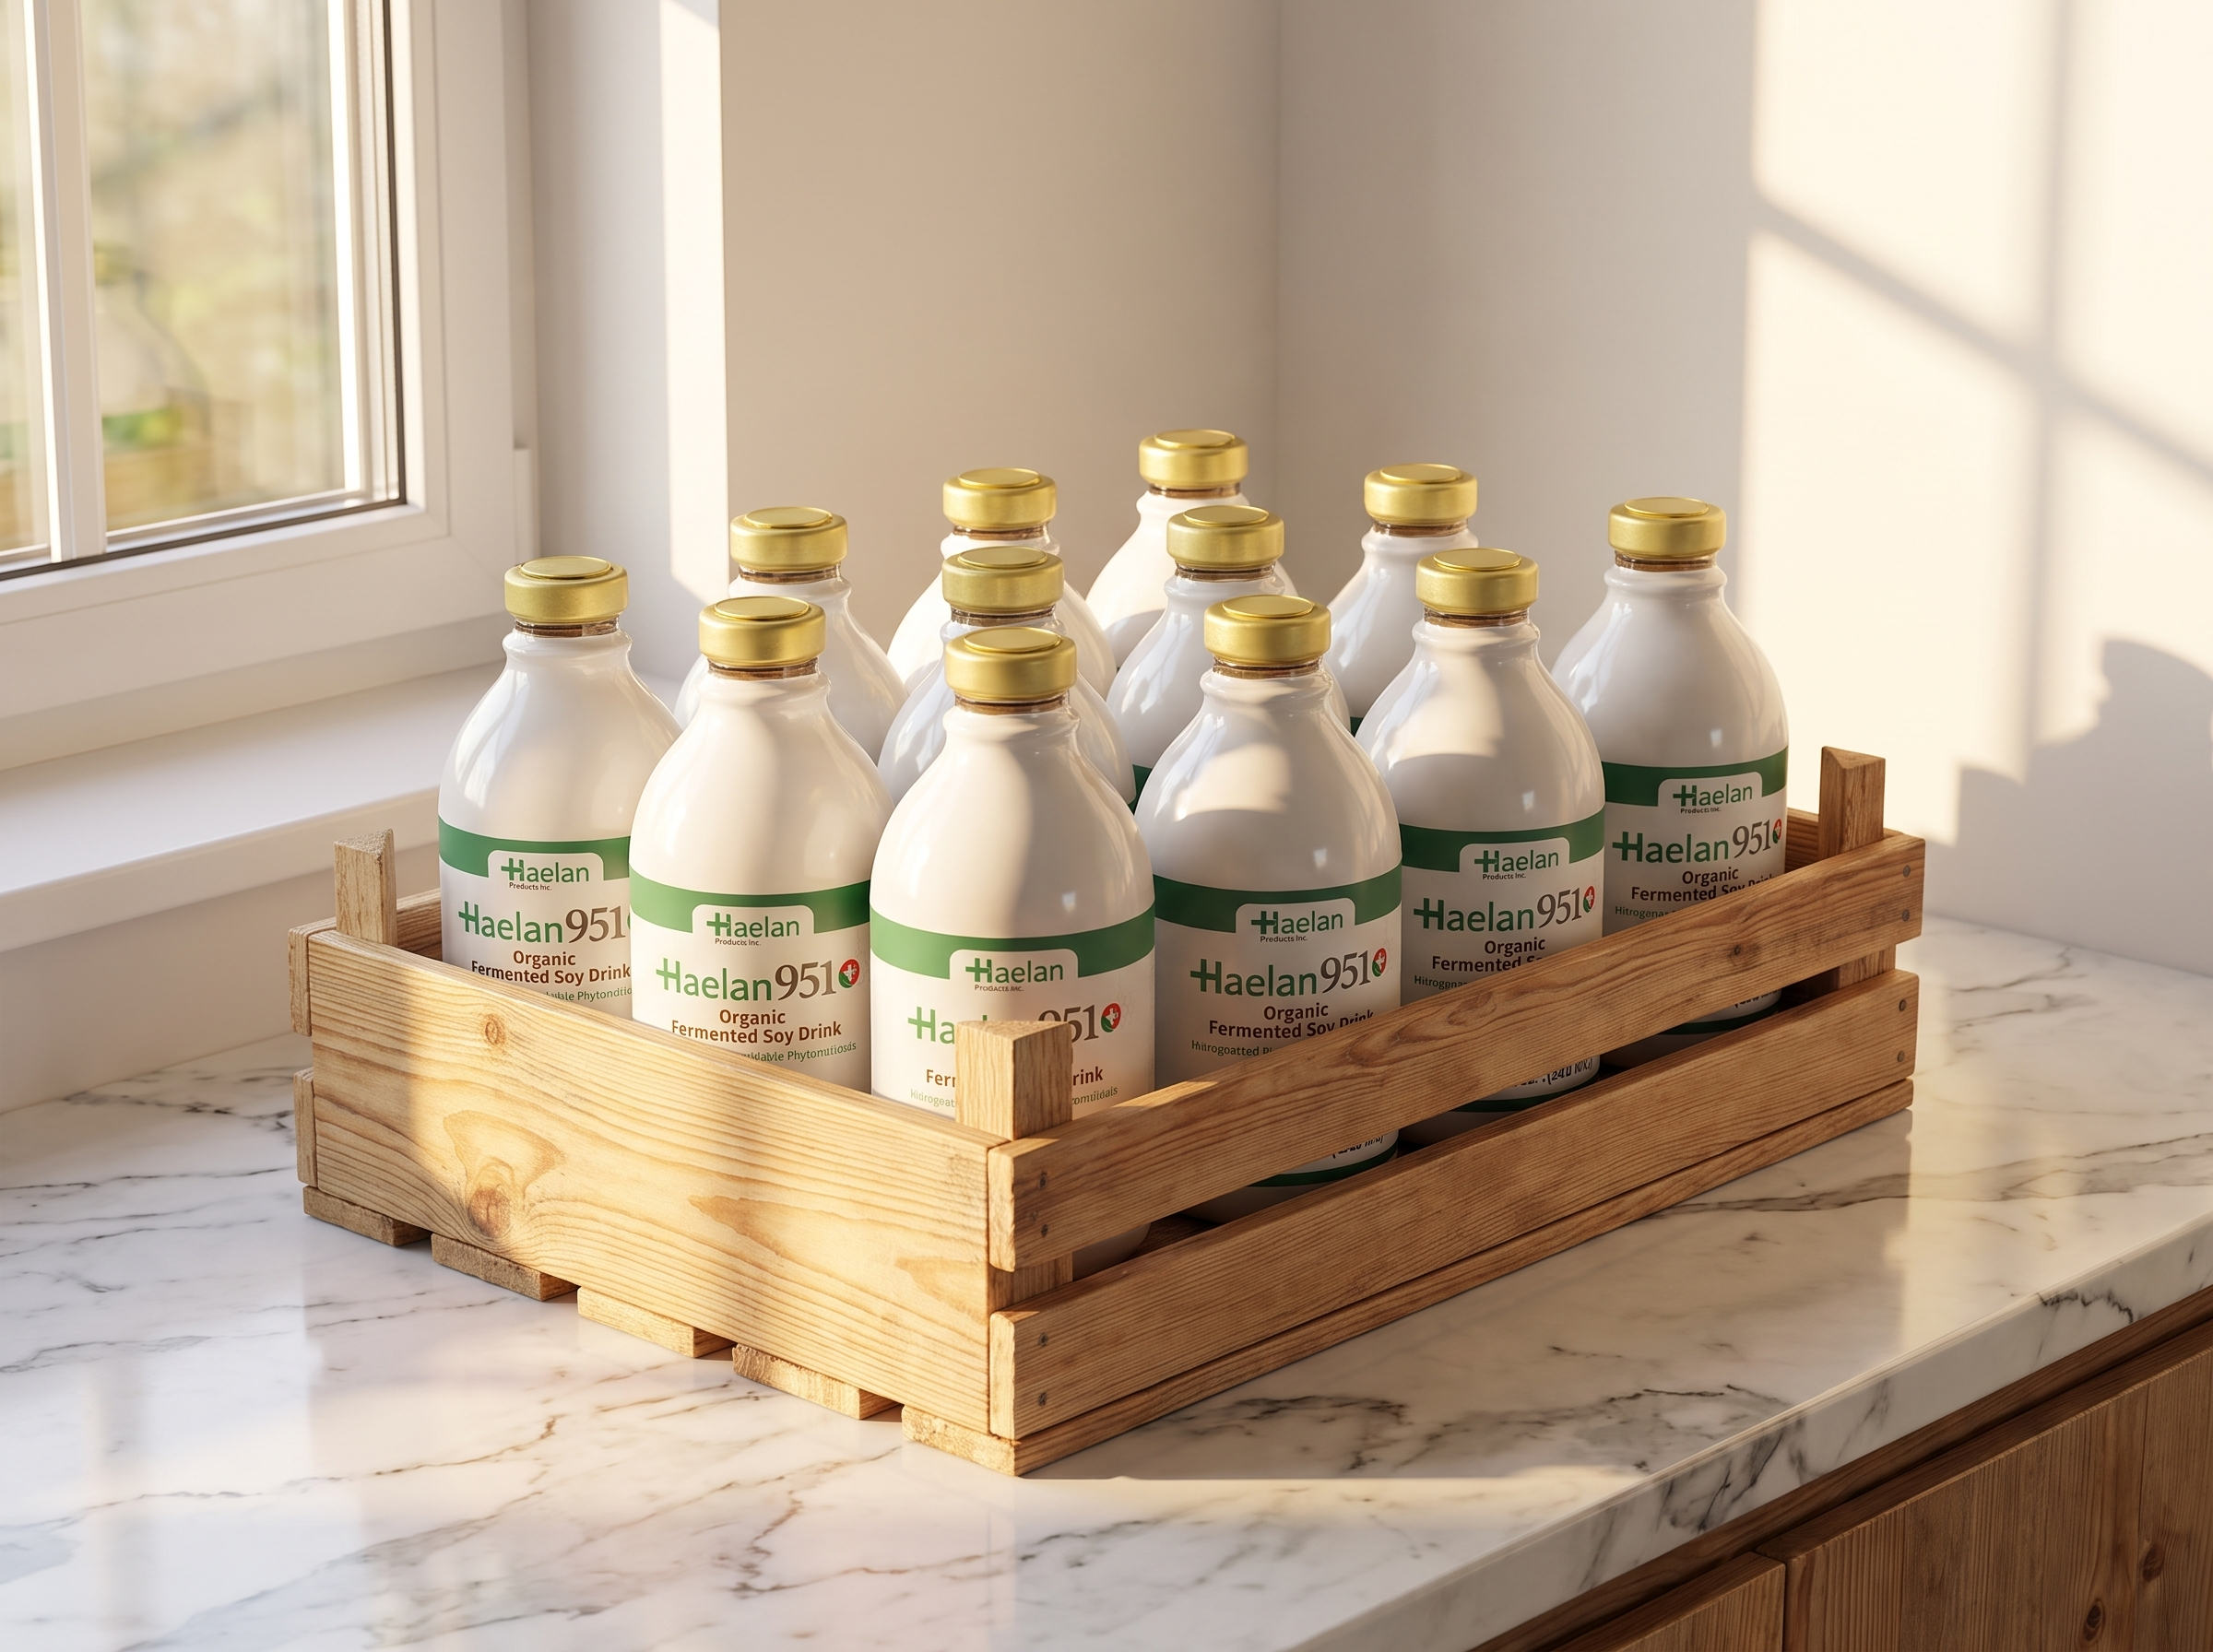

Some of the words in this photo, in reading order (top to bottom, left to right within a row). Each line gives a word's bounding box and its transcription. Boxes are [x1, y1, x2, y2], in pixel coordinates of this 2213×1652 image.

[1673, 784, 1752, 807] Haelan
[501, 858, 589, 882] Haelan
[1474, 849, 1559, 872] Haelan
[1682, 867, 1739, 887] Organic
[1631, 886, 1716, 902] Fermented
[706, 913, 799, 938] Haelan
[1251, 911, 1343, 935] Haelan
[1484, 937, 1545, 957] Organic
[514, 950, 576, 969] Organic
[1432, 956, 1521, 973] Fermented
[471, 961, 549, 984] Fermented
[554, 971, 584, 986] Soy
[589, 964, 631, 982] Drink
[965, 958, 1063, 983] Haelan
[719, 1009, 786, 1028] Organic
[1263, 1002, 1329, 1023] Organic
[672, 1020, 758, 1044] Fermented
[763, 1030, 794, 1045] Soy
[799, 1021, 842, 1041] Drink
[1209, 1020, 1301, 1038] Fermented
[1072, 1067, 1104, 1086] rink
